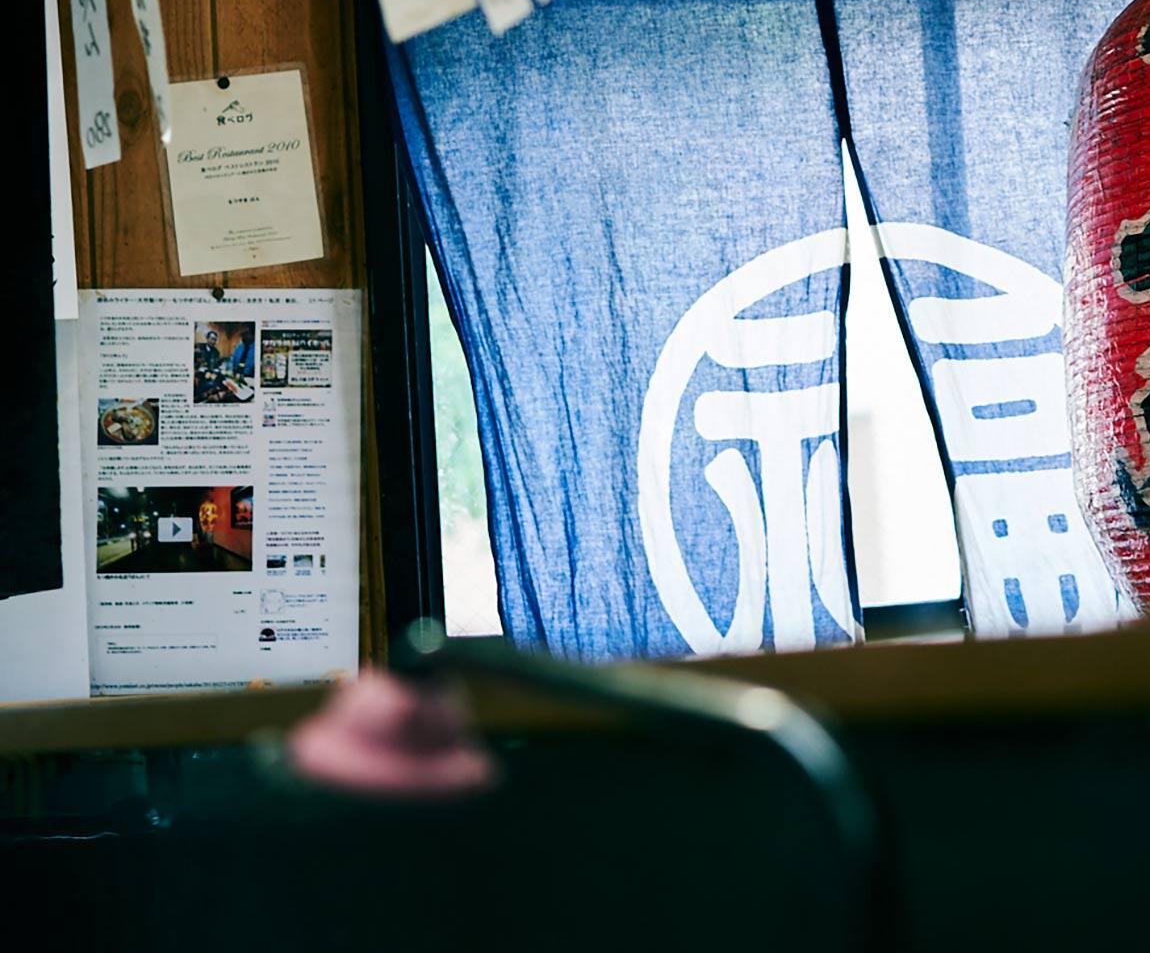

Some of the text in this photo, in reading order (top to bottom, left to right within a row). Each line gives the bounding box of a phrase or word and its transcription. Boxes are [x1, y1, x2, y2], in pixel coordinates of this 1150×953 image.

[177, 139, 301, 163] Best Restaurant 2010
